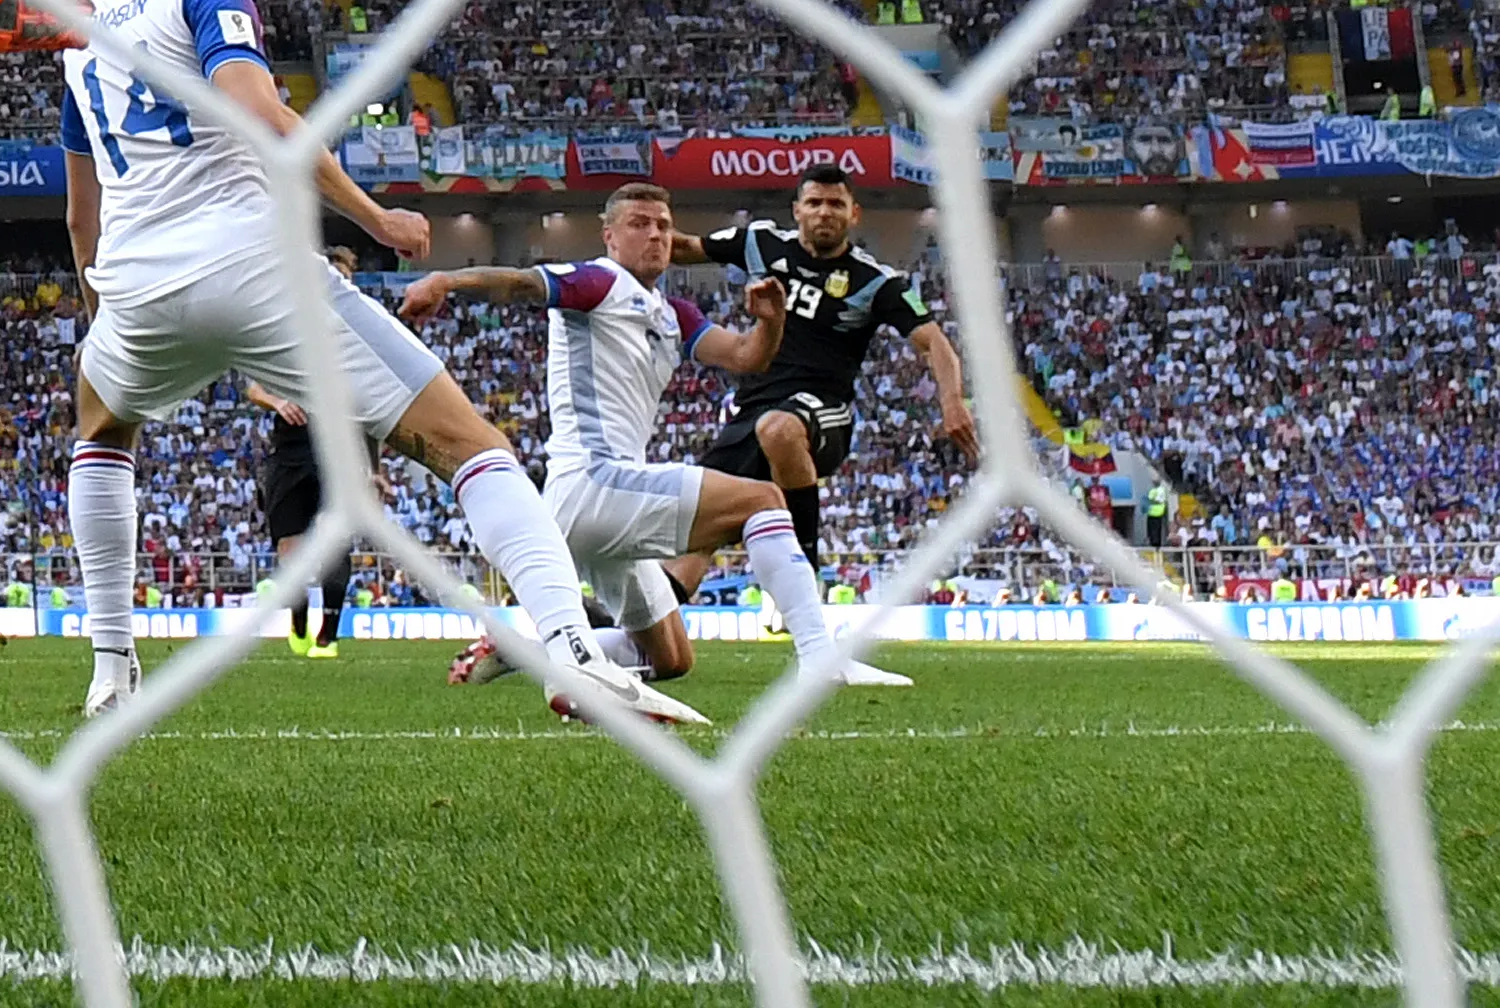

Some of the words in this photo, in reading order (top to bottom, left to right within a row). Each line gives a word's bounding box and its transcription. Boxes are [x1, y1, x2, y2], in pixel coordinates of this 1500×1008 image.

[80, 41, 196, 179] 14
[785, 278, 823, 320] 19
[945, 609, 1087, 641] GAZPROM
[1246, 605, 1396, 641] GAZPROM
